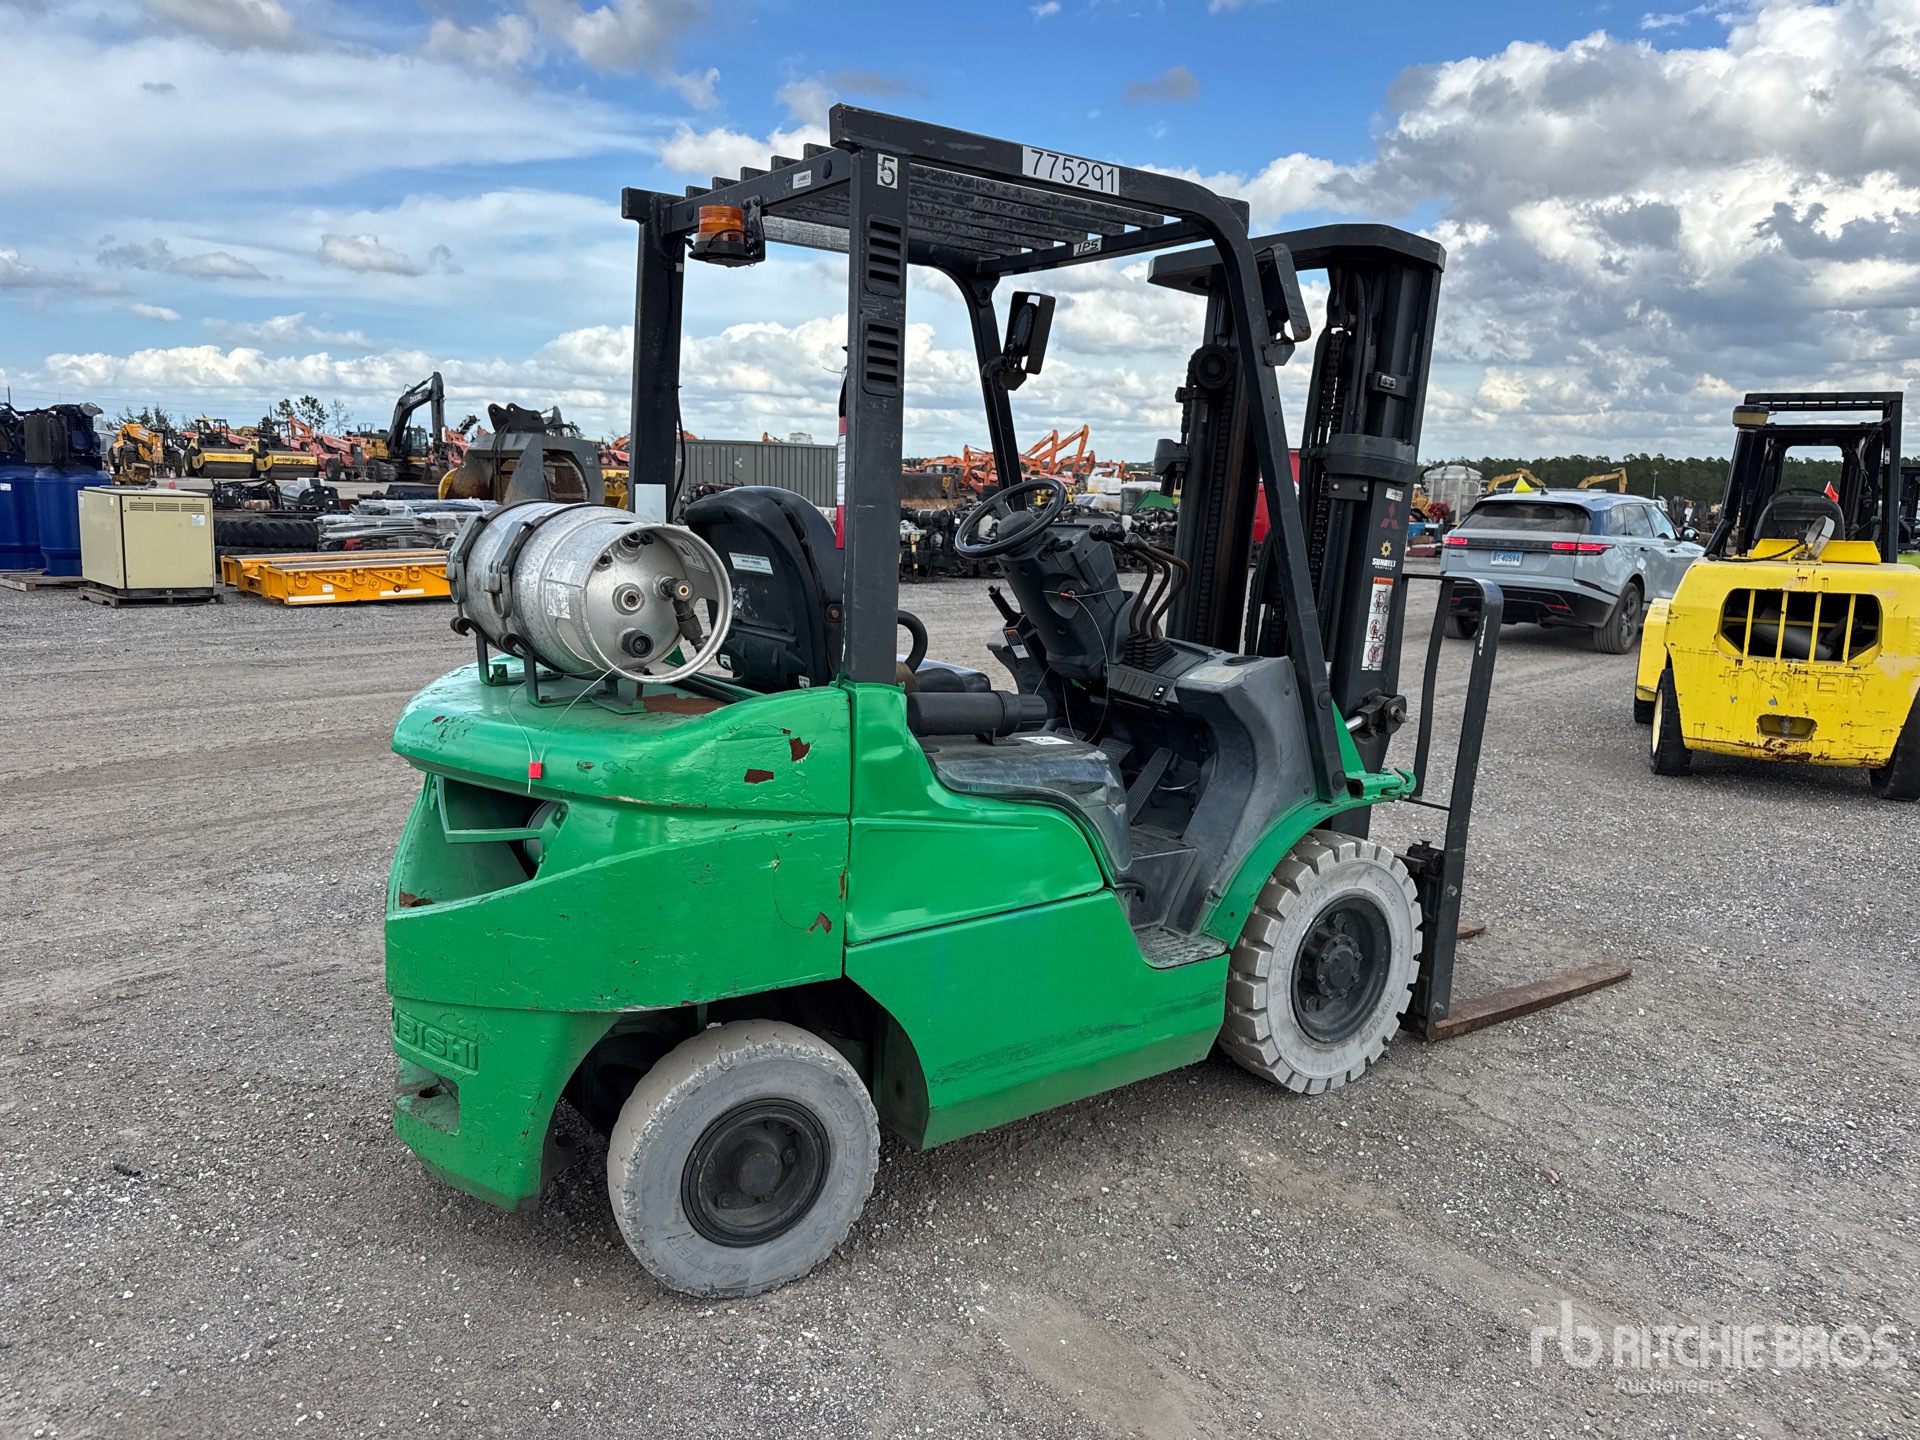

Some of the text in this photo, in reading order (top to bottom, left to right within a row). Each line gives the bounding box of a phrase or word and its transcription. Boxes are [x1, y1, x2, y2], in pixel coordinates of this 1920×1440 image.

[879, 155, 896, 187] 5
[1030, 149, 1117, 194] 775291
[1371, 557, 1397, 568] SUNBELT
